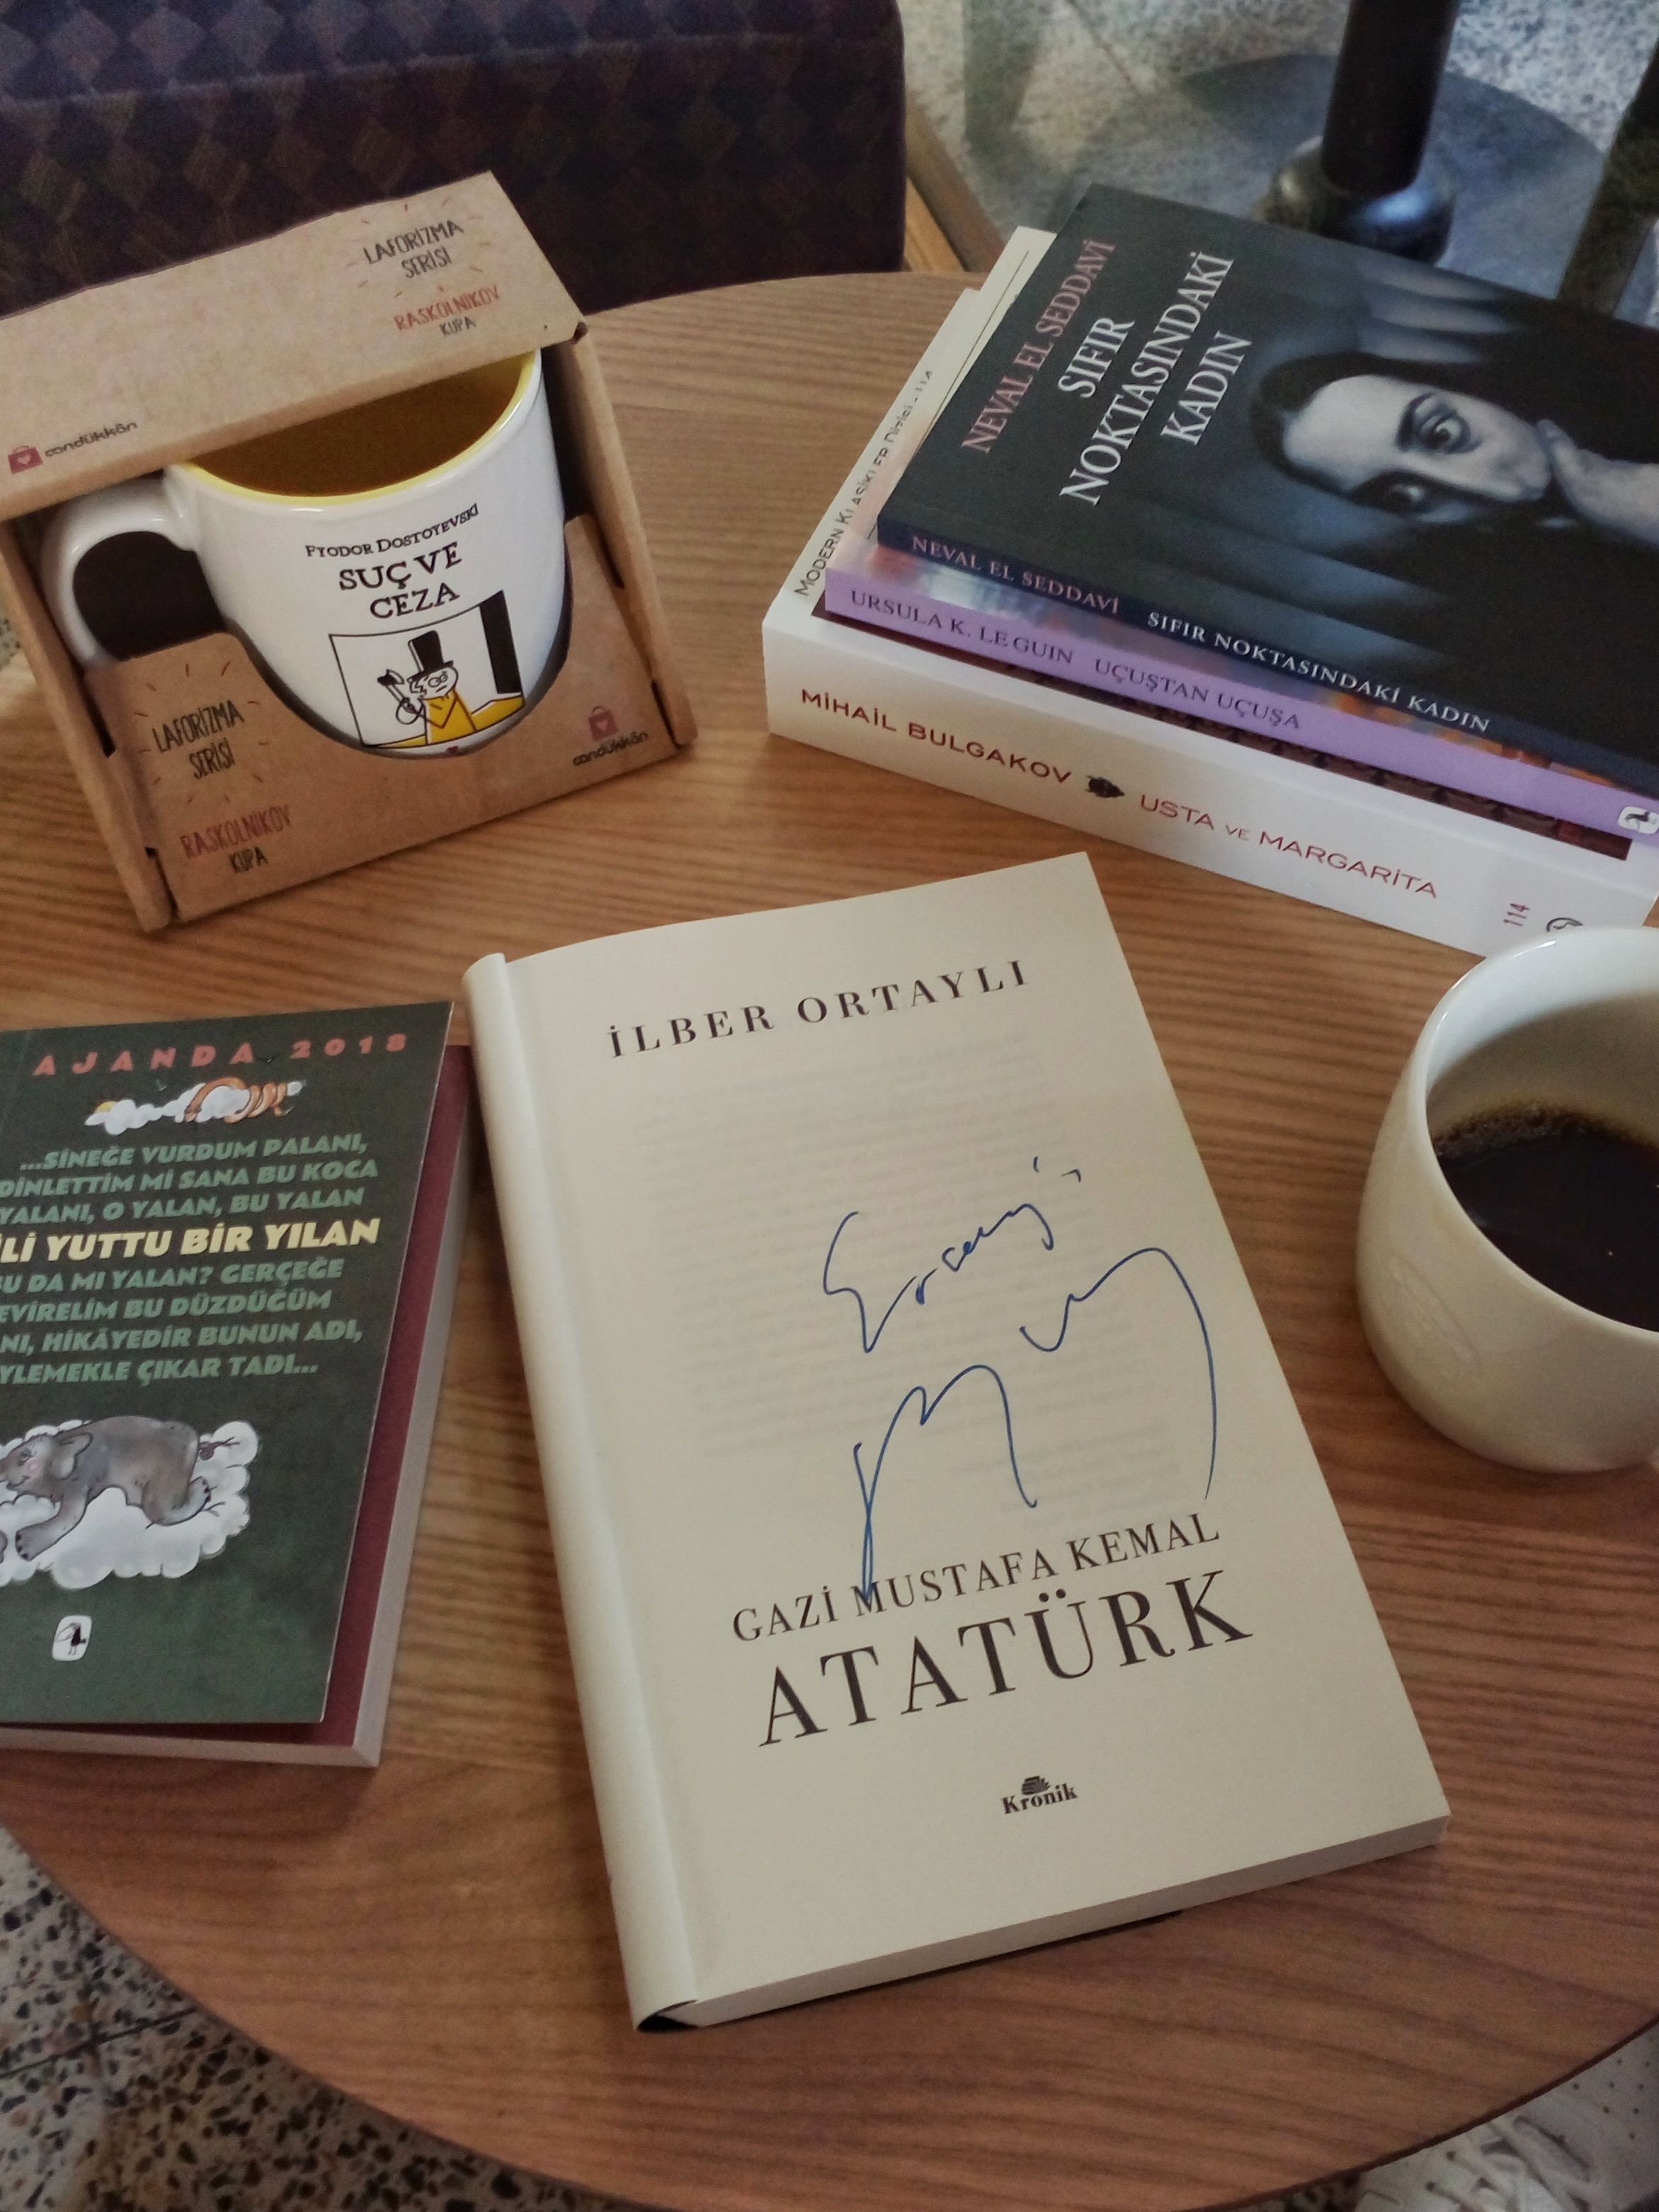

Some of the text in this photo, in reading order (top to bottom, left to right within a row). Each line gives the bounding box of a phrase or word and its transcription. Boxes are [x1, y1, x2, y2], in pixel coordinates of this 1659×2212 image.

[439, 316, 477, 336] KUPA
[961, 239, 1116, 453] NEVAL EL SEDDAVİ
[1058, 318, 1136, 399] SIFIR
[1059, 251, 1235, 506] NOKTASINDAKİ
[1161, 330, 1253, 446] KADIN
[339, 541, 462, 591] SUÇ VE
[793, 529, 845, 596] MODERN
[370, 582, 460, 619] CEZA
[913, 535, 982, 571] NEVAL
[991, 560, 1015, 582] EL
[1146, 611, 1205, 642] SIFIR
[1214, 632, 1401, 704] NOKTASINDAKİ
[1408, 695, 1490, 733] KADIN
[851, 590, 1300, 729] URSULA K. LE GUIN UÇUŞTAN UÇUŞA
[801, 688, 897, 733] MİHAİL
[908, 722, 1073, 784] BULGAKOV
[1139, 794, 1214, 830] USTA
[1259, 830, 1437, 899] MARGARİTA
[1502, 902, 1530, 927] 114
[229, 846, 269, 874] KUPA
[608, 959, 1030, 1059] İLBER ORTAYLI
[32, 1033, 407, 1076] AJANDA 2018
[142, 1140, 258, 1165] VURDUM
[262, 1132, 367, 1157] PALANI,
[139, 1168, 174, 1192] Mİ
[178, 1168, 250, 1190] SANA
[256, 1164, 297, 1185] BU
[301, 1158, 379, 1182] KOCA
[102, 1202, 125, 1221] O
[132, 1195, 223, 1219] YALAN,
[229, 1193, 270, 1214] BU
[276, 1186, 365, 1211] YALAN
[0, 1216, 382, 1264] Lİ YUTTU BİR YILAN
[0, 1274, 23, 1294] U
[26, 1271, 64, 1293] DA
[71, 1270, 106, 1292] MI
[111, 1265, 215, 1289] YALAN?
[122, 1297, 165, 1319] BU
[169, 1287, 333, 1317] DÜZDÜĞÜM
[197, 1321, 300, 1347] BUNUN
[303, 1318, 363, 1343] ADI,
[137, 1357, 222, 1388] ÇIKAR
[732, 1512, 1220, 1643] GAZİ MUSTAFA KEMAL
[758, 1568, 1255, 1748] ATATÜRK
[1000, 1782, 1079, 1815] Kronik
